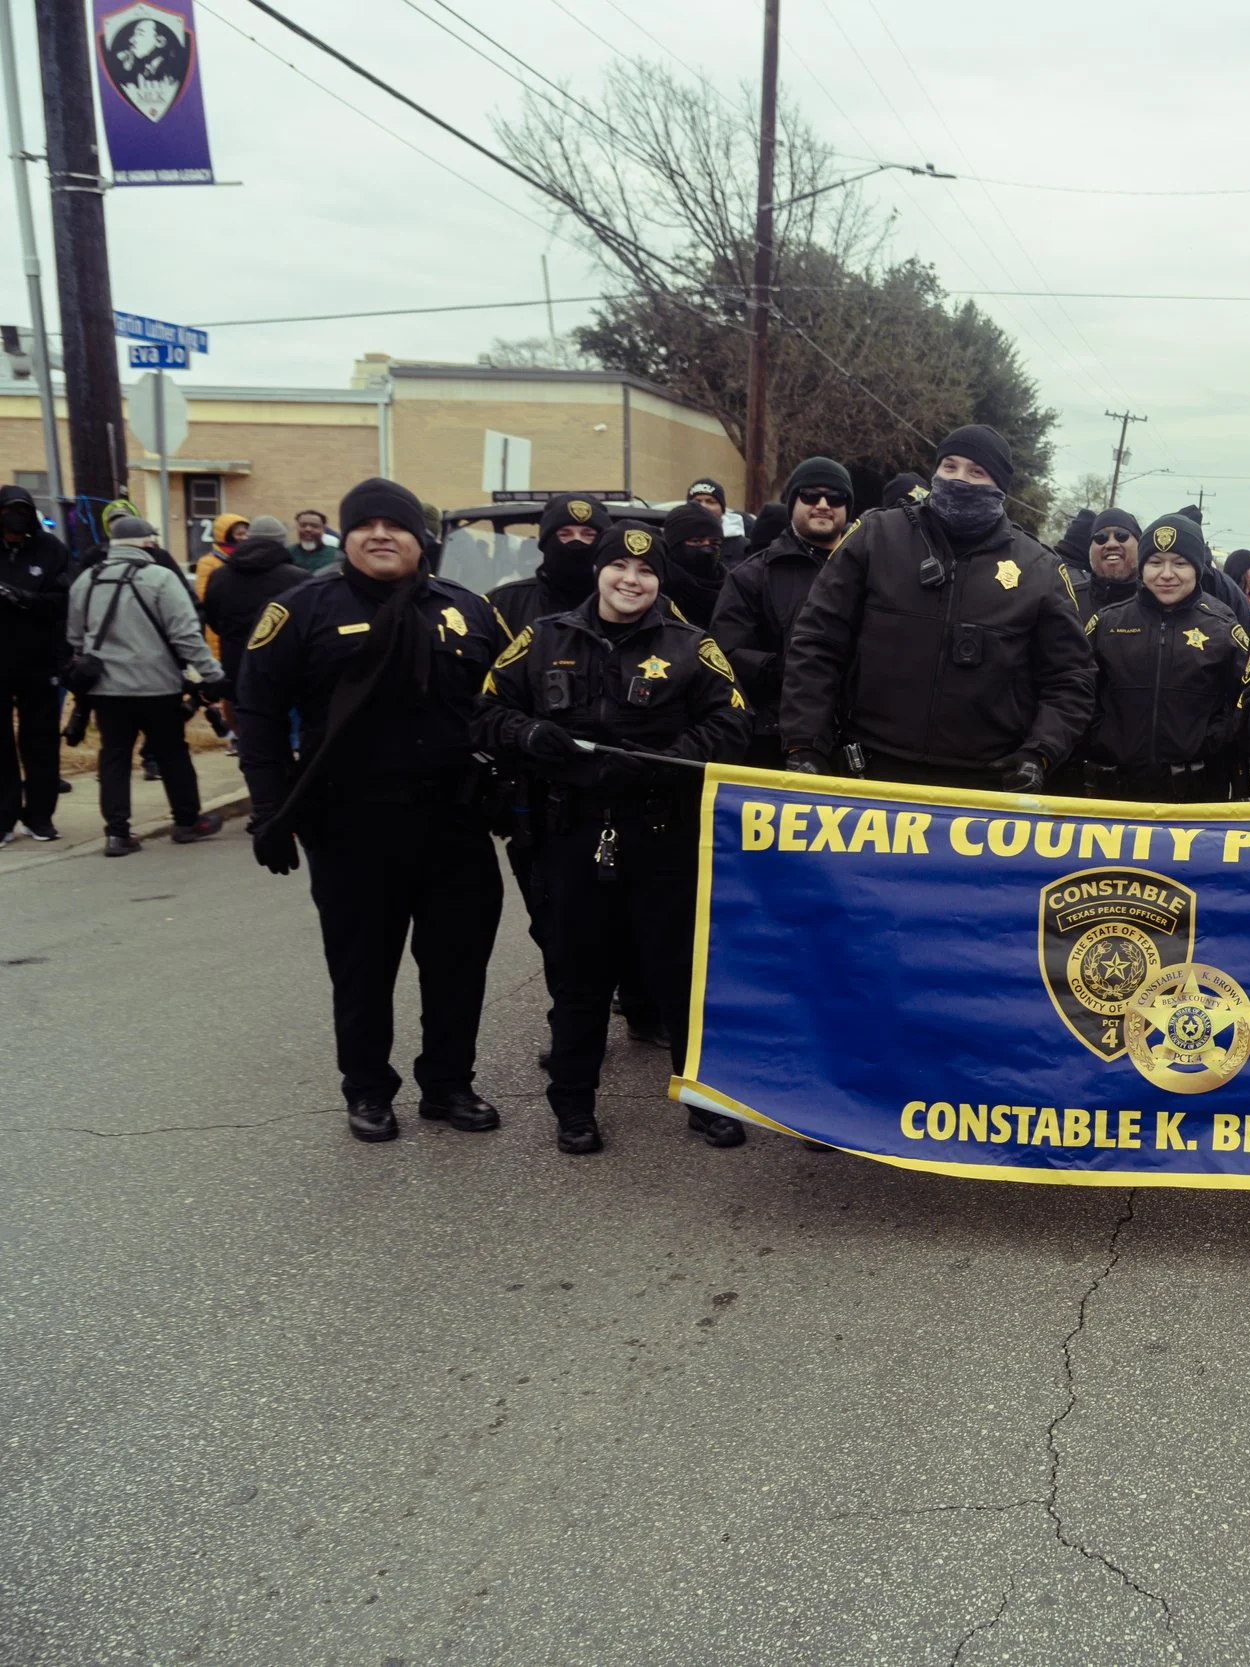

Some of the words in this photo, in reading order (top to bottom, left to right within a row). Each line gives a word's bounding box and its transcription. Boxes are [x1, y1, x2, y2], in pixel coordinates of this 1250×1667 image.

[131, 345, 160, 363] Eva
[165, 344, 185, 363] Jo
[741, 801, 931, 854] BEXAR
[949, 817, 1206, 862] COUNTY
[1048, 879, 1187, 915] CONSTABLE
[1066, 908, 1096, 923] TEXAS
[1098, 906, 1127, 914] PEACE
[1129, 907, 1168, 926] OFFICER
[1072, 941, 1087, 961] THE
[1086, 925, 1118, 943] STATE
[1121, 926, 1136, 937] OF
[1137, 935, 1158, 966] TEXAS
[1071, 978, 1105, 1012] COUNTY
[1109, 1004, 1122, 1013] OF
[1137, 970, 1184, 1006] CONSTABLE
[1201, 971, 1211, 981] K.
[1213, 976, 1243, 1006] BROWN
[1189, 995, 1221, 1007] COUNTY
[1102, 1019, 1120, 1027] PCT
[1101, 1028, 1118, 1048] 4
[1173, 1052, 1194, 1063] PCT.
[900, 1100, 1142, 1149] CONSTABLE
[1155, 1111, 1197, 1150] K.
